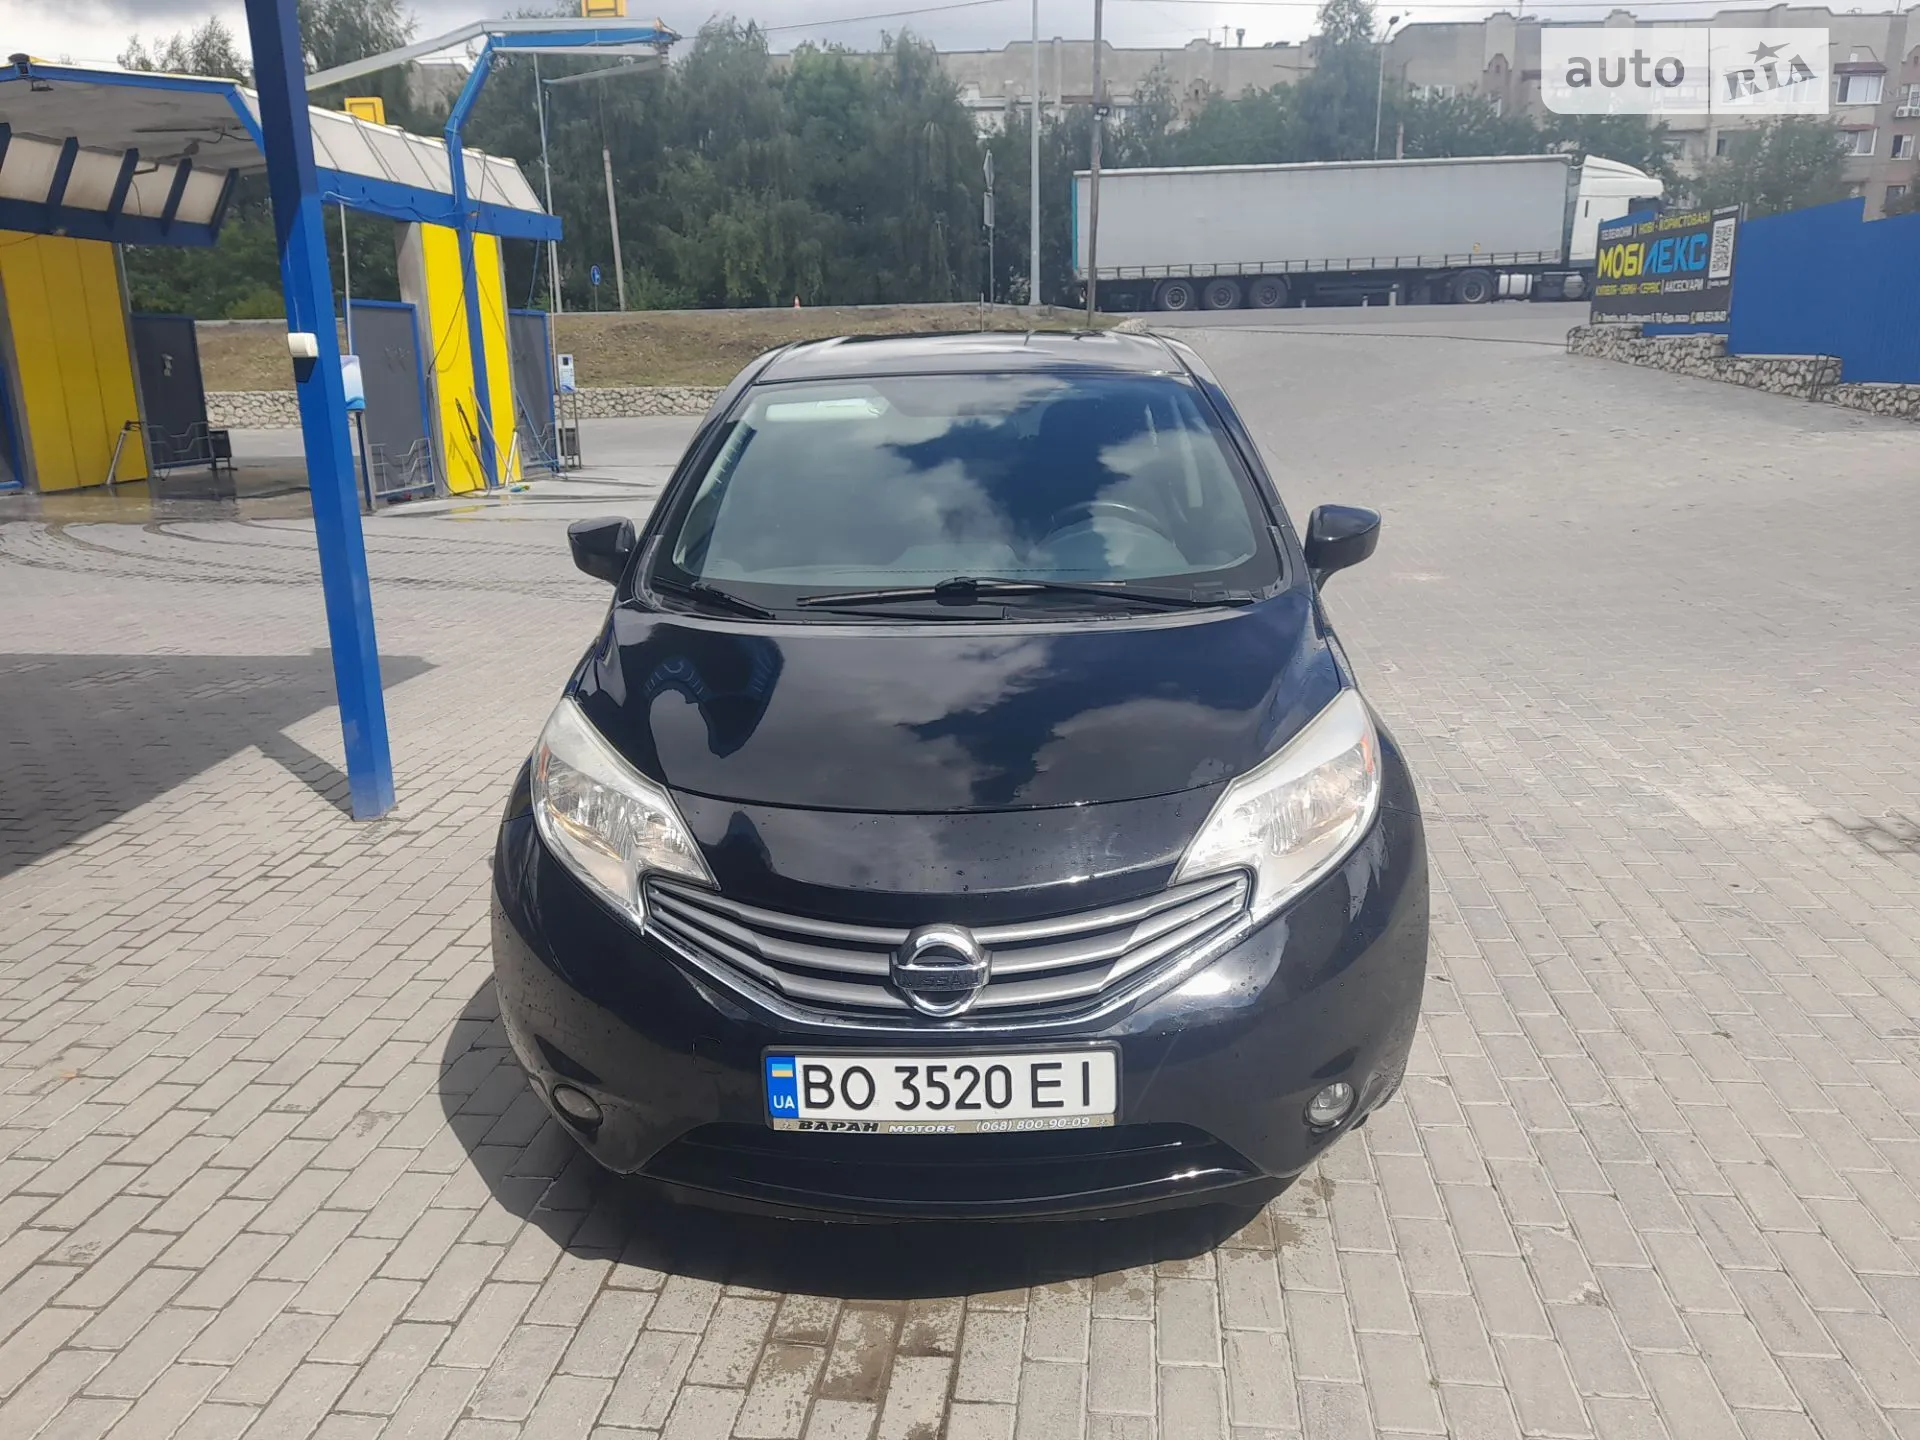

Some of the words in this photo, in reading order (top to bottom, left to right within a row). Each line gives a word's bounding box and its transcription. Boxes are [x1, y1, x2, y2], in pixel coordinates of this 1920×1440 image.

[894, 1064, 1013, 1111] 3520
[773, 1094, 795, 1110] UA
[889, 1124, 956, 1134] MOTORS
[976, 1119, 1013, 1132] (068)
[1017, 1116, 1090, 1131] 800-90-09
